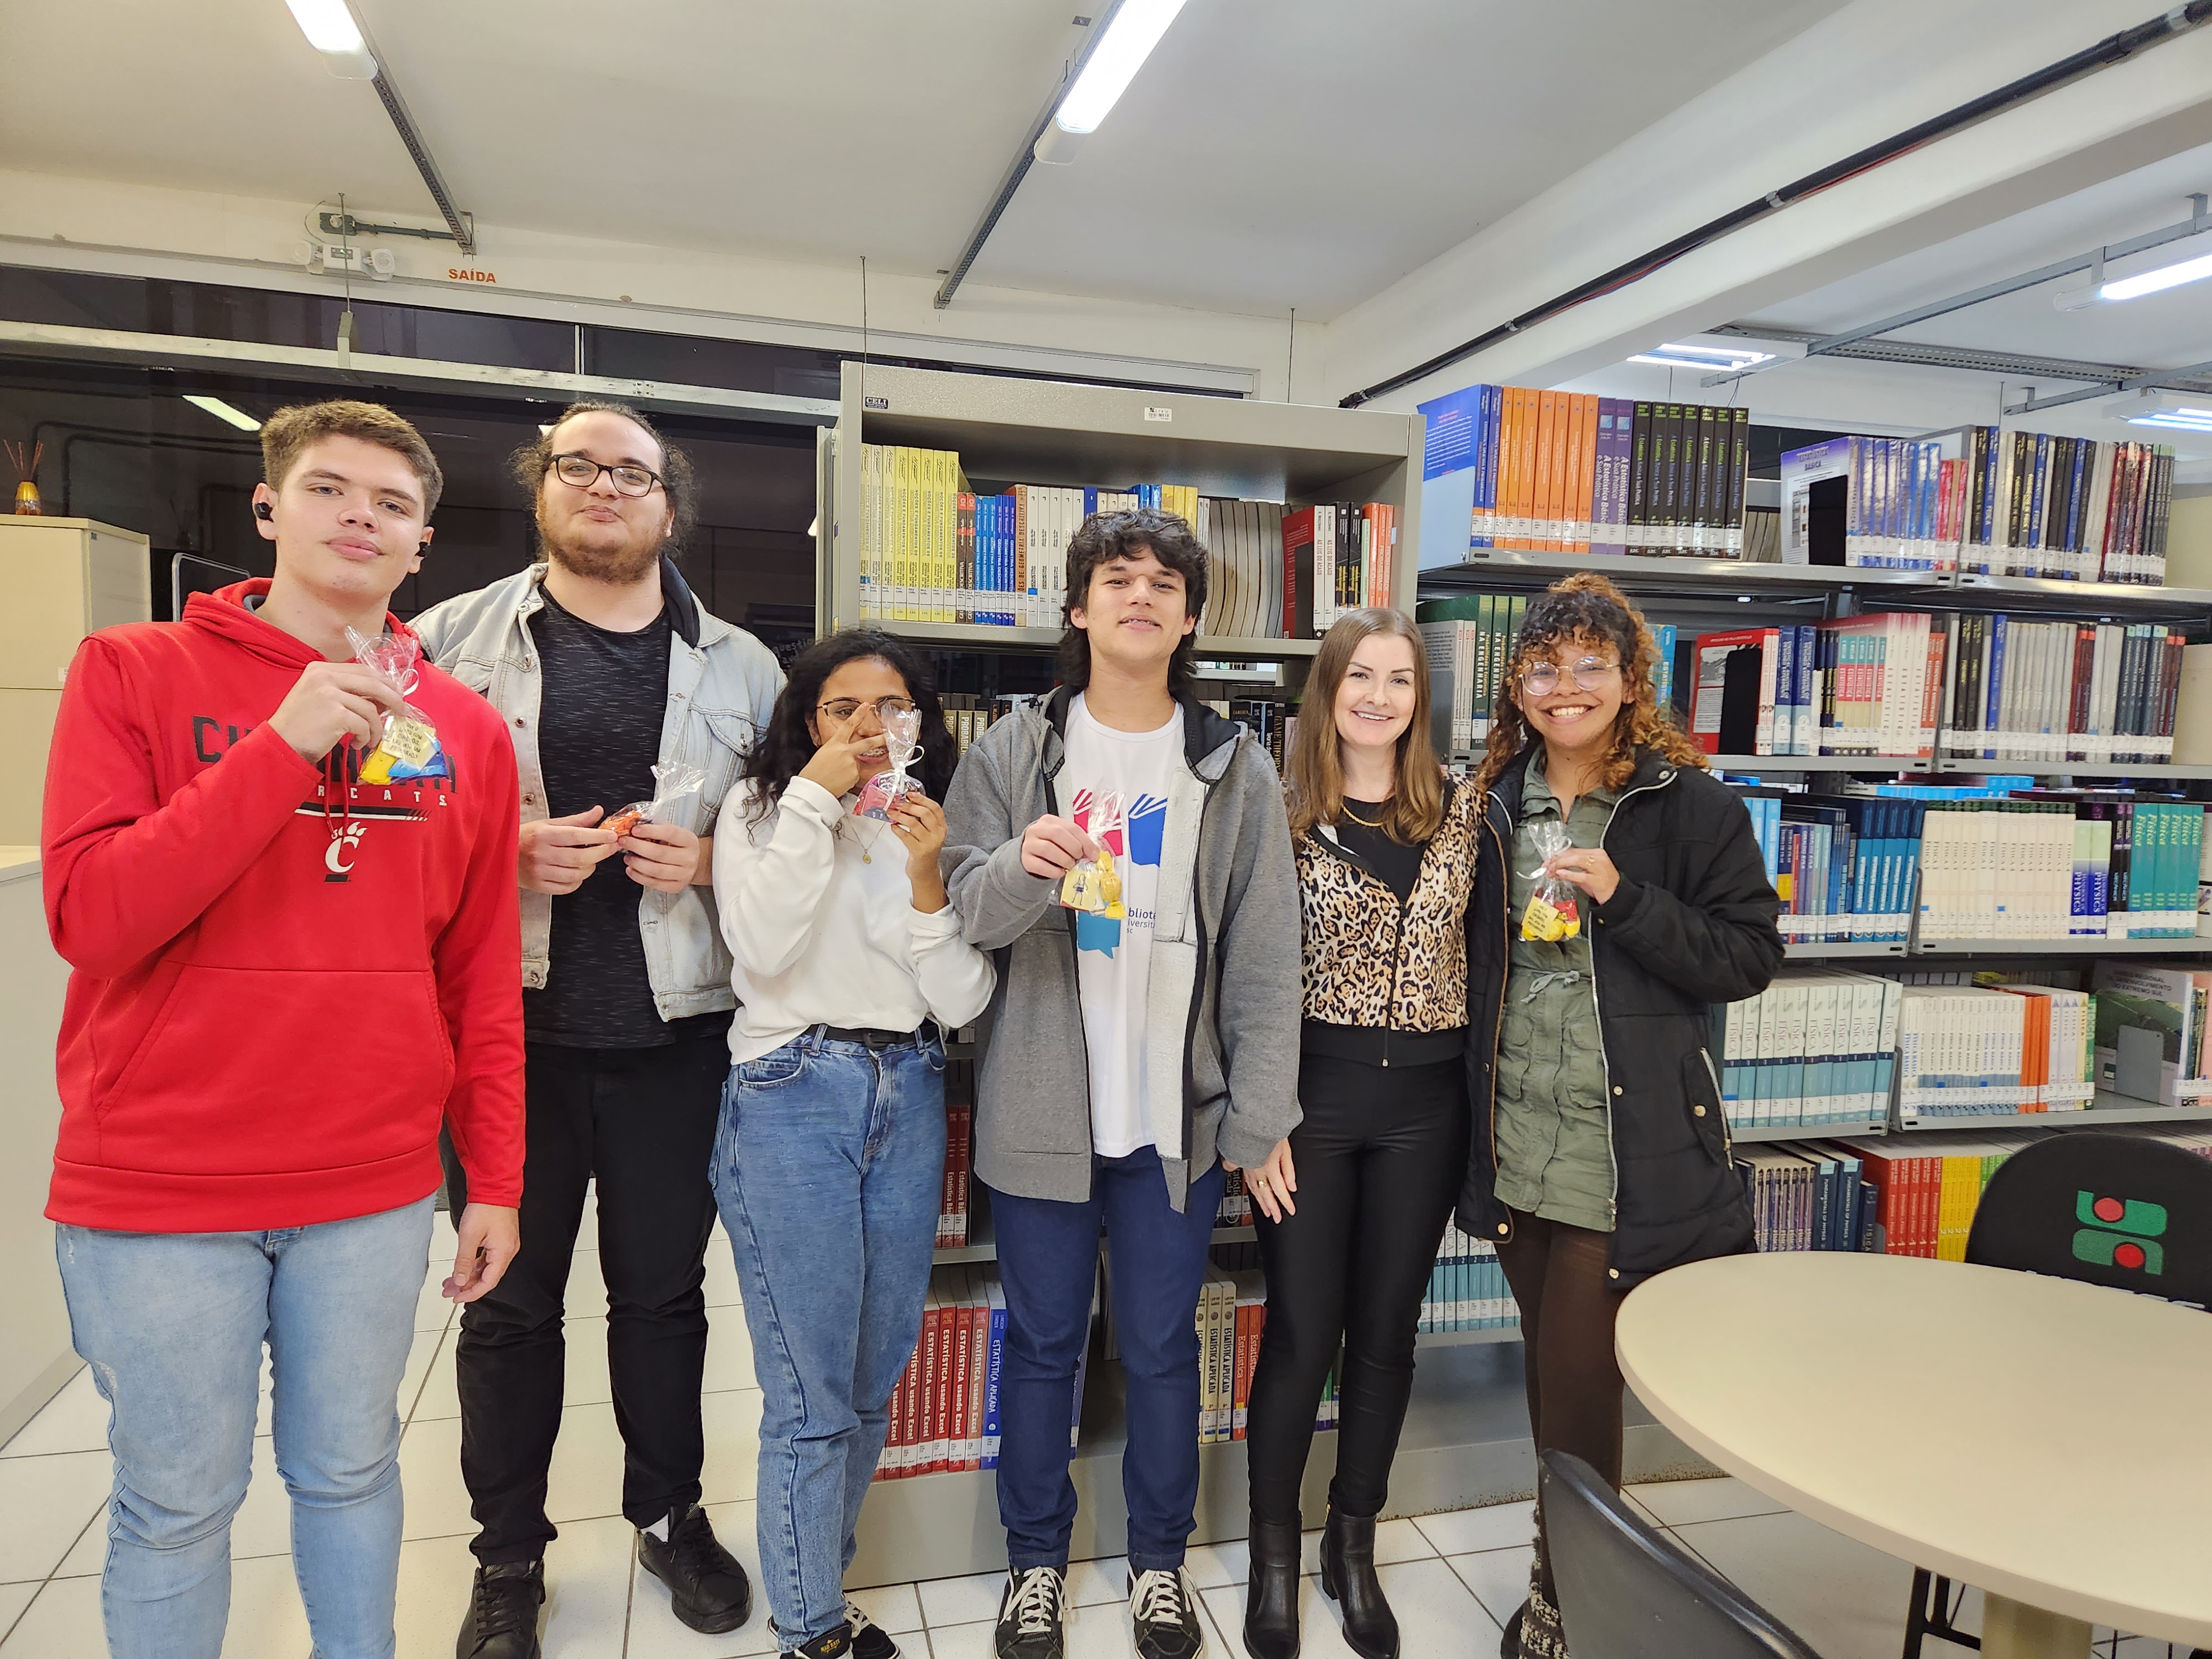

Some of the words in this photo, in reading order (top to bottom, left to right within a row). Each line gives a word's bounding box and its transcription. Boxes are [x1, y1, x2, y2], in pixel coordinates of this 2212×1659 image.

[448, 268, 496, 283] SAÍDA
[1602, 462, 1611, 500] Estatística
[1619, 464, 1629, 502] Estatística
[1600, 502, 1609, 524] Básic
[1618, 503, 1626, 524] Básic
[1019, 571, 1024, 580] DE
[1479, 632, 1486, 642] NA
[1495, 632, 1502, 643] NA
[1476, 645, 1485, 698] ENGENHARIA
[1492, 646, 1501, 700] ENGENHARIA
[1883, 668, 1893, 729] ESTATÍSTIC
[1897, 669, 1907, 729] ESTATÍSTIC
[1274, 716, 1282, 738] GAME
[2073, 872, 2082, 913] PHYSICS
[2094, 872, 2102, 913] PHYSICS
[1128, 907, 1156, 920] bliote
[925, 1332, 935, 1385] ESTATÍSTICA
[941, 1329, 950, 1382] ESTATÍSTICA
[957, 1329, 967, 1383] ESTATÍSTICA
[974, 1329, 983, 1381] ESTATÍSTICA
[990, 1339, 1001, 1381] ESTATÍSTICA
[1209, 1328, 1218, 1363] ESTATÍSTICA
[1222, 1328, 1232, 1363] ESTATÍSTICA
[1238, 1335, 1246, 1378] Estatística
[1250, 1334, 1259, 1377] Estatística
[988, 1384, 998, 1413] APLICADA
[1208, 1365, 1217, 1394] APLICADA
